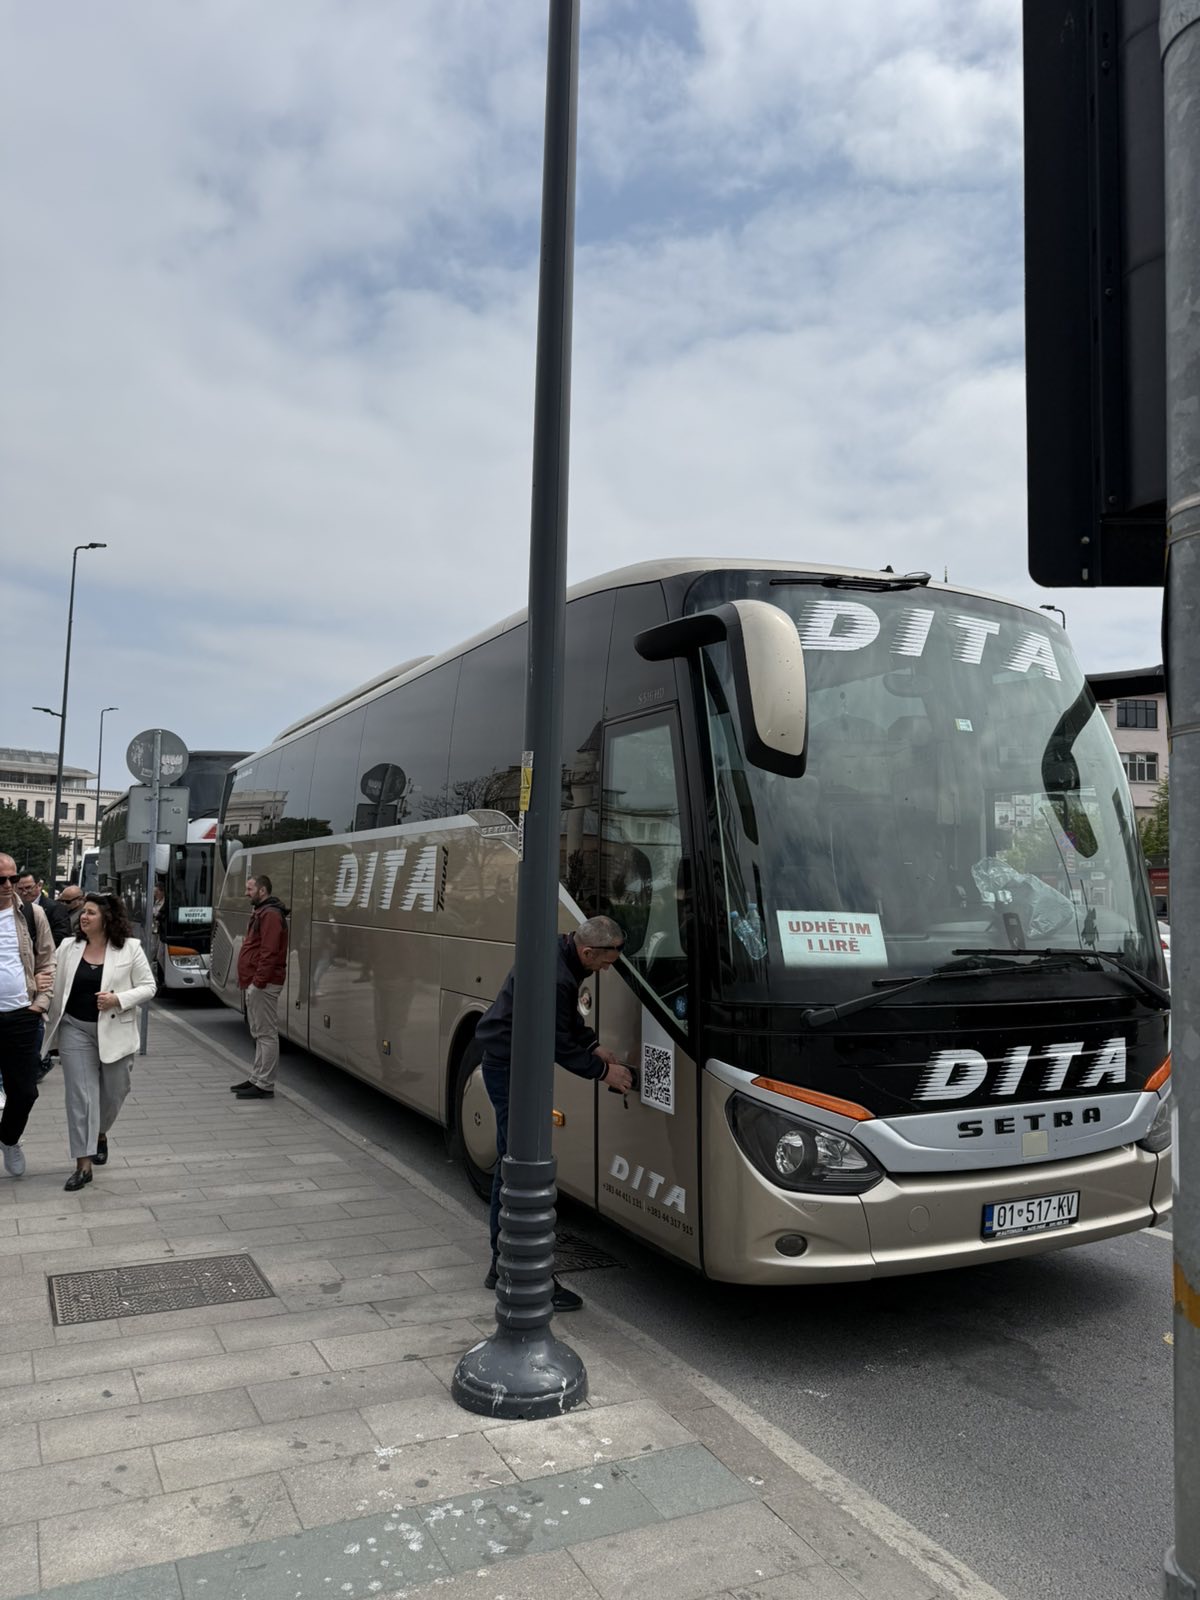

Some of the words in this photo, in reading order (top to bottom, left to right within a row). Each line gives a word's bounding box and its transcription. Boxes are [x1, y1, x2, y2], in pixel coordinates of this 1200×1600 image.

[800, 600, 1061, 681] DITA
[481, 825, 513, 834] SETRA
[332, 846, 438, 912] DITA
[436, 846, 449, 912] Travel
[788, 918, 872, 935] UDHËTIM
[807, 939, 814, 950] I
[818, 937, 860, 952] LIRË
[911, 1037, 1127, 1101] DITA
[957, 1107, 1102, 1139] SETRA
[608, 1155, 687, 1215] DITA
